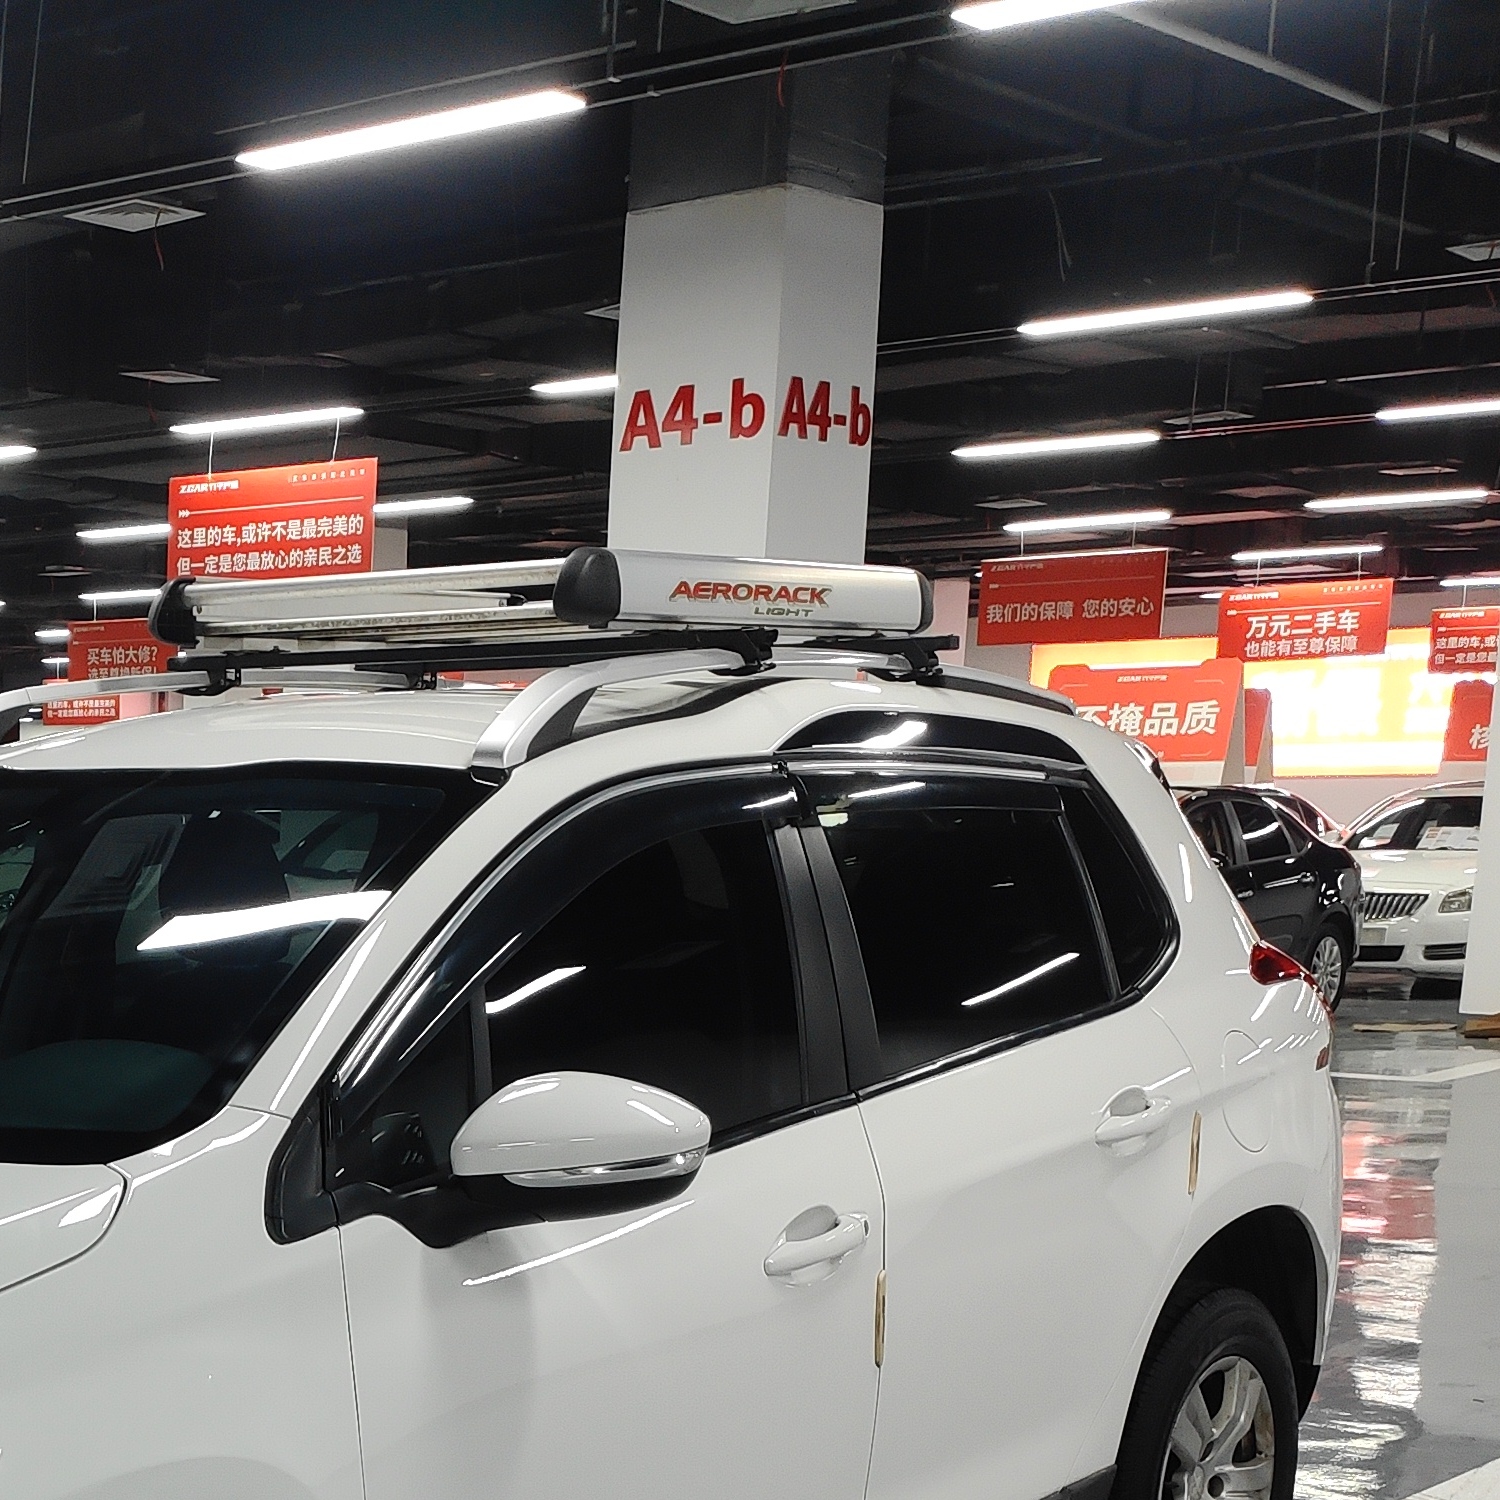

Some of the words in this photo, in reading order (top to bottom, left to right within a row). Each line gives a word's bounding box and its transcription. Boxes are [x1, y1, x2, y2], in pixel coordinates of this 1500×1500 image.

[619, 378, 766, 452] A4-b
[777, 376, 871, 447] A4-b
[177, 544, 362, 577] 但一定是您最放心的亲民之选
[668, 581, 833, 607] AERORACK
[754, 607, 813, 617] LIGHT
[986, 600, 1074, 624] 我们的保障
[1082, 597, 1154, 618] 您的安心
[1246, 609, 1361, 639] 万元二手车
[1244, 635, 1359, 658] 也能有至尊保障
